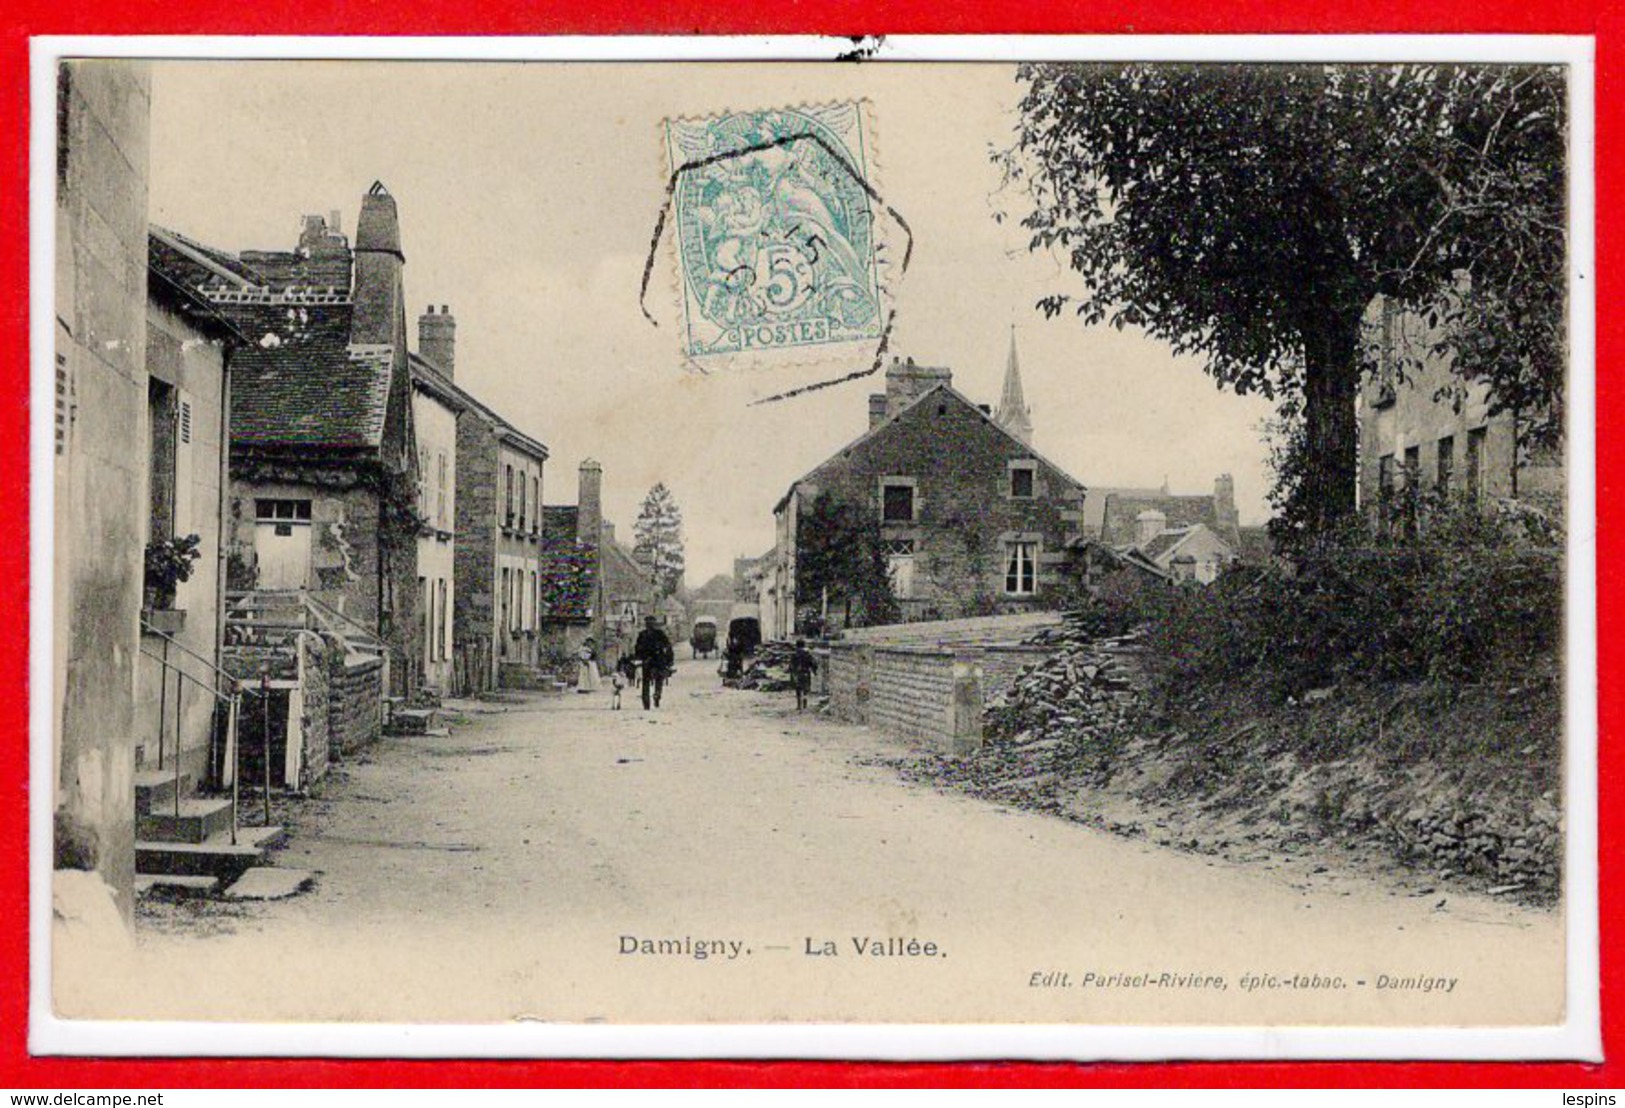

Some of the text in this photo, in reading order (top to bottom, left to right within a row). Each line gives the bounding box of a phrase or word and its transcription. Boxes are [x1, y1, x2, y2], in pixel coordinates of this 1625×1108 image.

[743, 321, 826, 347] POSTES
[618, 935, 752, 960] Damigny.
[804, 937, 838, 957] La
[851, 937, 948, 958] Vallée.
[1028, 972, 1073, 988] Edit.
[1375, 974, 1458, 992] Damigny
